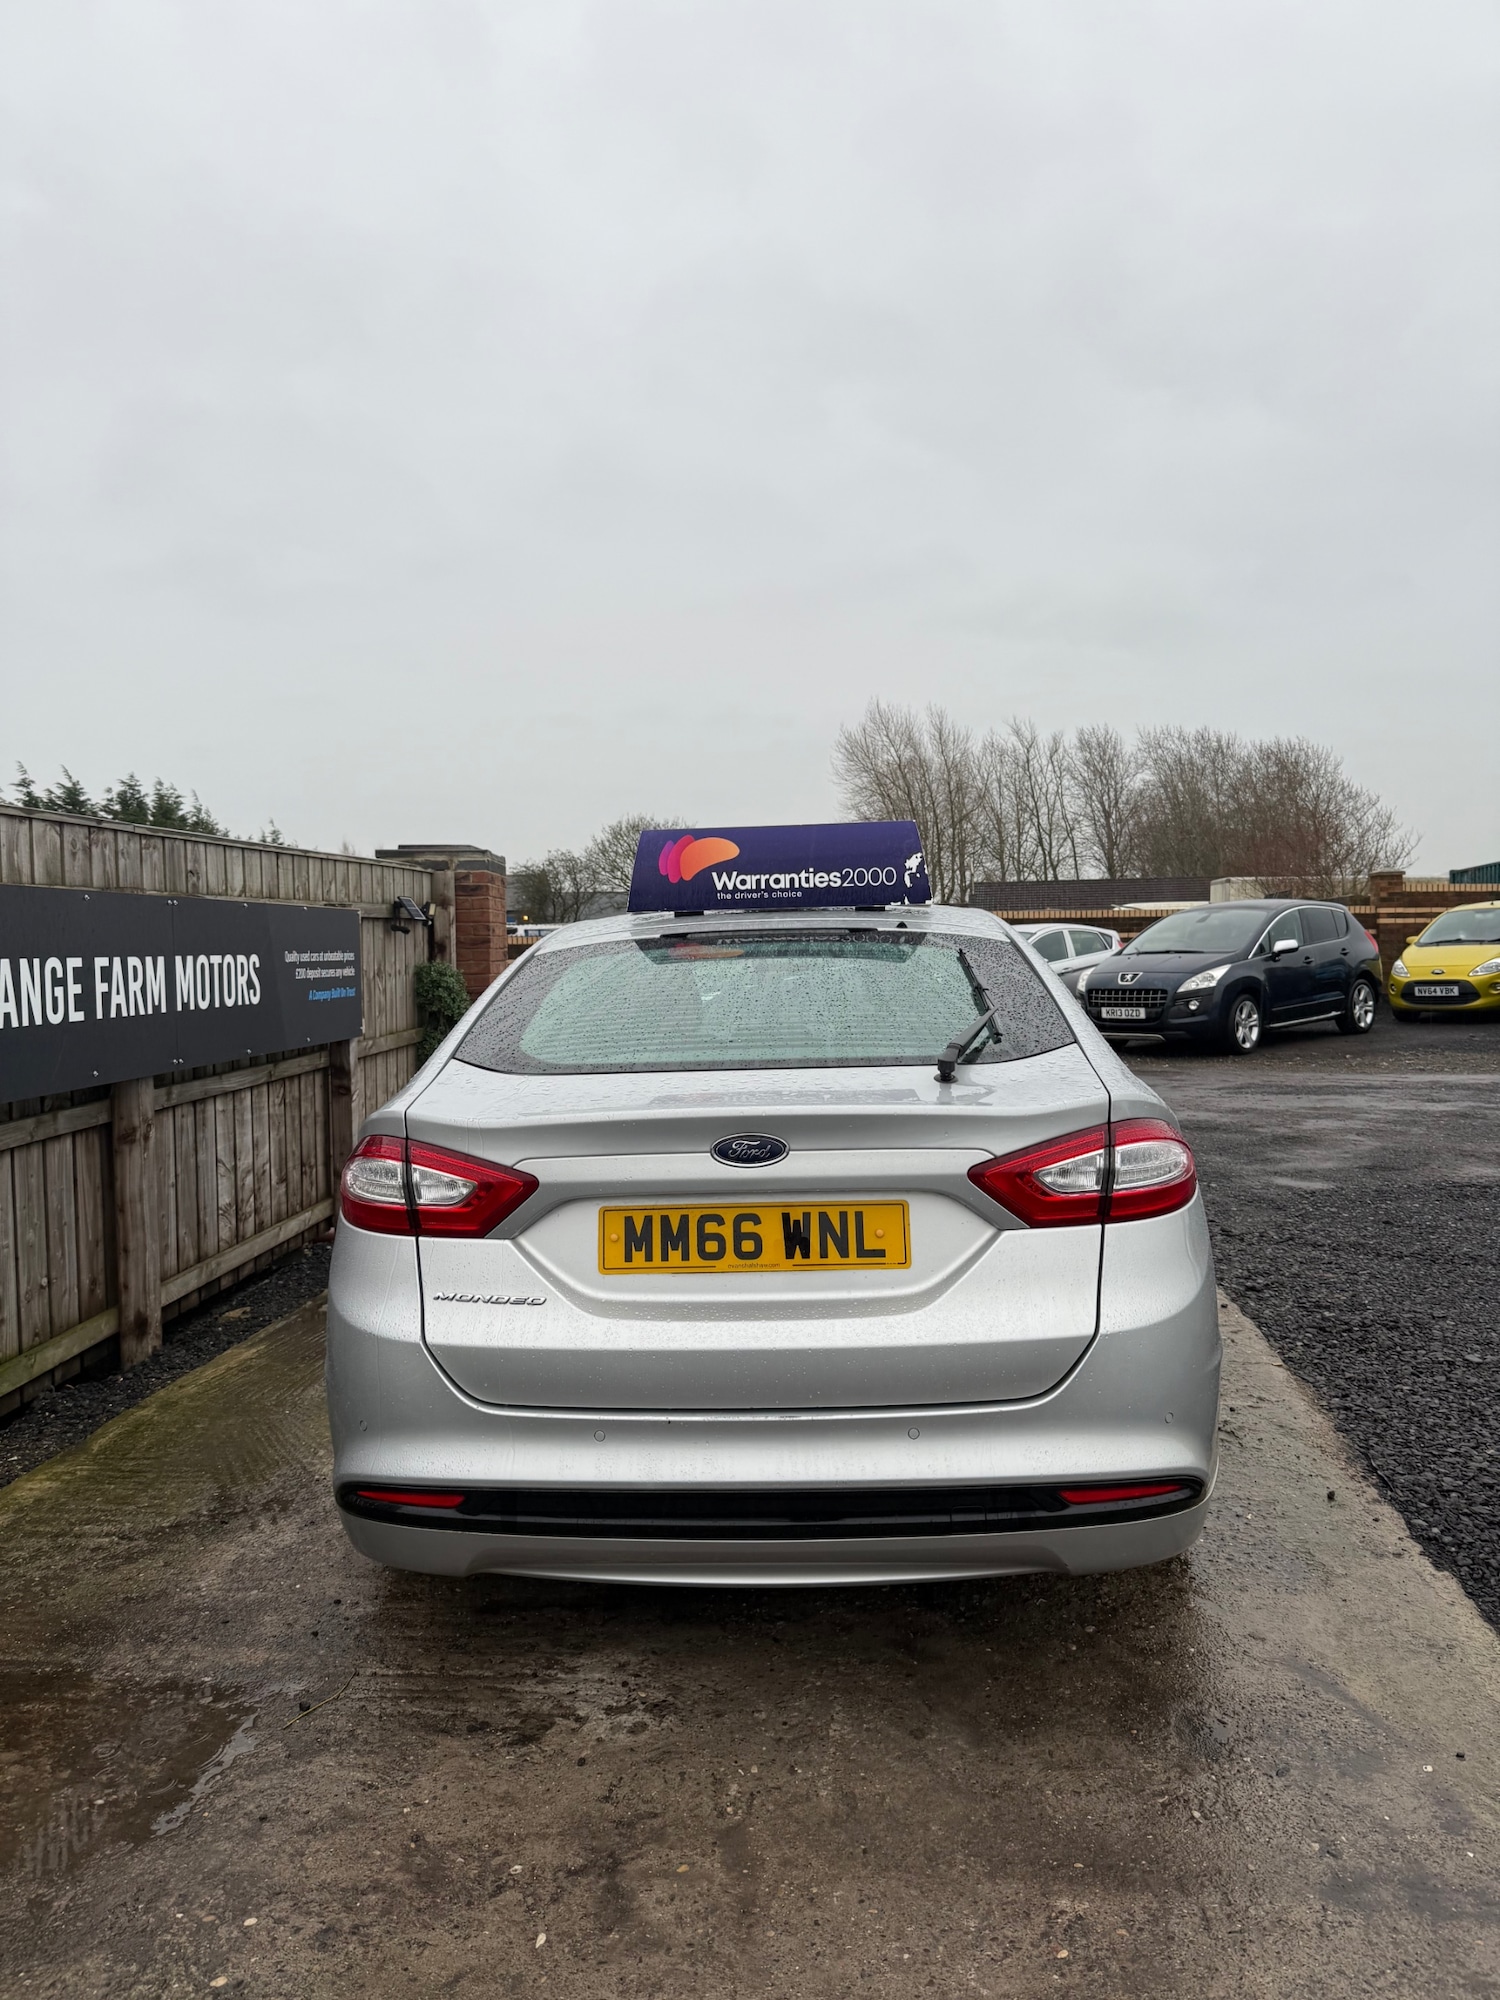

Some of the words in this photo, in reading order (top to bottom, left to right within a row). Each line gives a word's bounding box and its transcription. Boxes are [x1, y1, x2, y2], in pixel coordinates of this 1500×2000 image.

[711, 867, 897, 891] Warranties2000
[717, 892, 732, 900] the
[735, 890, 769, 900] driver's
[772, 890, 803, 898] choice
[0, 957, 85, 1029] ANGE
[94, 956, 167, 1020] FARM
[175, 954, 261, 1012] MOTORS
[1417, 987, 1437, 995] NV64
[1439, 987, 1456, 995] VBK
[1105, 1008, 1123, 1017] KR13
[728, 1139, 771, 1159] Ford
[624, 1213, 763, 1263] MM66
[781, 1211, 887, 1260] WNL
[433, 1291, 548, 1306] MONDEO
